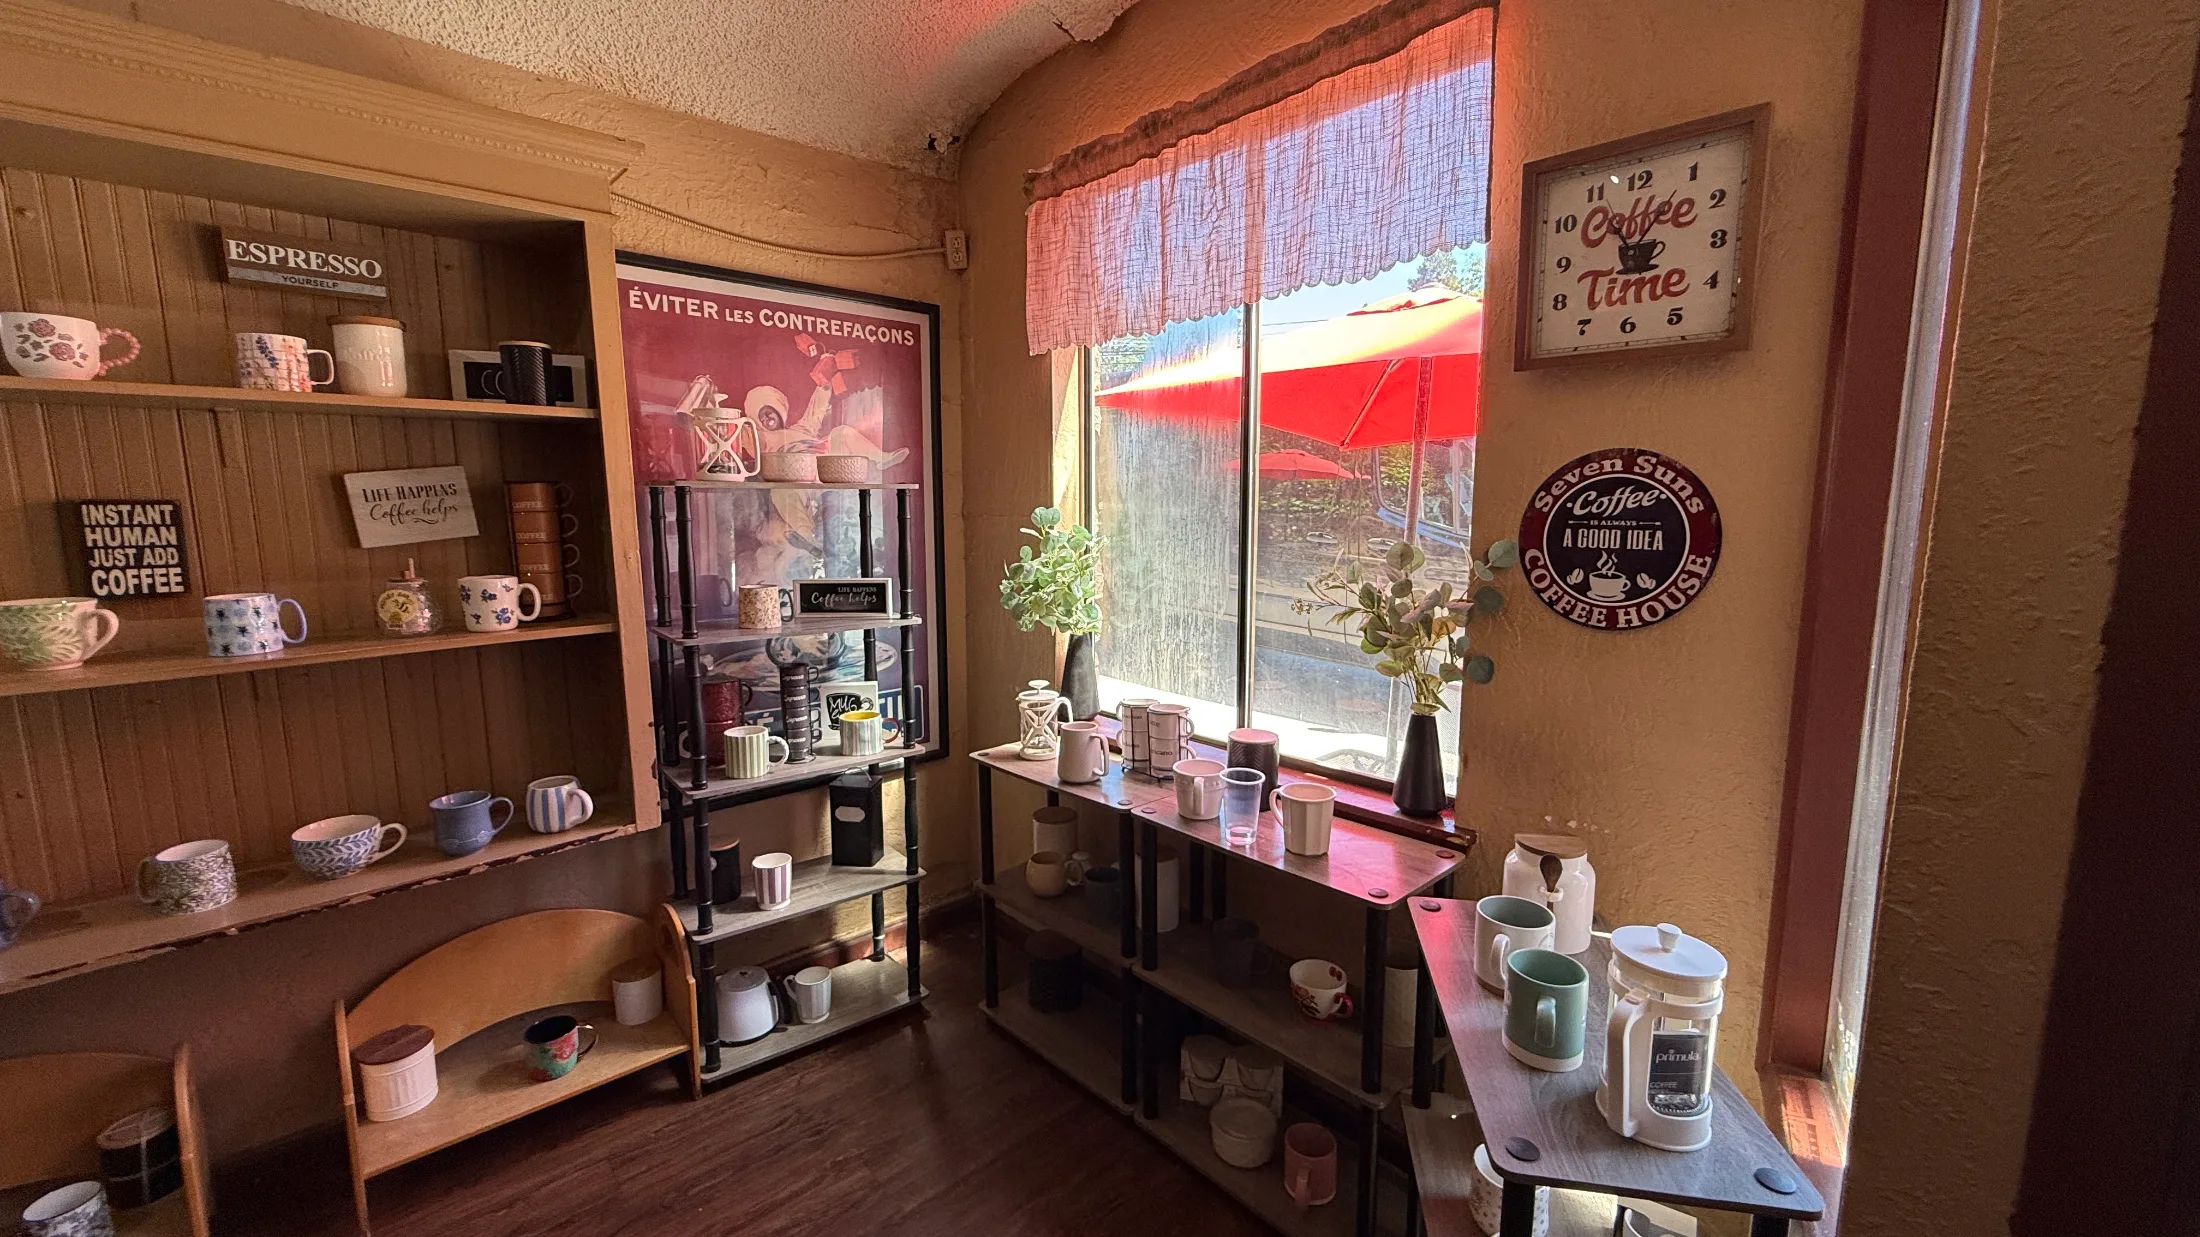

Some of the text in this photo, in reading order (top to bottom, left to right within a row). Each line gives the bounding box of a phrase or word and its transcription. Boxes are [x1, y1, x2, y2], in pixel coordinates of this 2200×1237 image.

[1627, 170, 1653, 192] 12
[1688, 162, 1698, 181] 1
[1586, 182, 1605, 203] 11
[1708, 188, 1727, 209] 2
[1555, 214, 1578, 234] 10
[1580, 194, 1698, 248] Coffee
[1709, 229, 1728, 249] 3
[226, 239, 383, 279] ESPRESSO
[1555, 256, 1572, 273] 9
[281, 275, 339, 290] YOURSELF
[1577, 267, 1690, 311] Time
[1702, 270, 1720, 290] 4
[1552, 293, 1568, 311] 8
[628, 286, 915, 347] ÉVITER LES CONTREFAÇONS
[1619, 316, 1637, 334] 6
[1666, 307, 1684, 326] 5
[1577, 318, 1592, 336] 7
[362, 482, 458, 503] LIFE HAPPENS
[1534, 455, 1705, 514] Seven Suns
[512, 501, 544, 509] COFFEE
[1573, 485, 1660, 517] Coffee
[81, 504, 173, 526] INSTANT
[369, 497, 458, 526] Coffee helps
[84, 526, 178, 547] HUMAN
[515, 532, 547, 540] COFFEE
[1563, 528, 1663, 551] A GOOD IDEA
[88, 547, 180, 568] JUST ADD
[520, 563, 551, 571] COFFEE
[91, 567, 185, 597] COFFEE
[1524, 548, 1712, 628] COFFEE HOUSE
[811, 592, 877, 607] Coffee helps
[829, 695, 858, 712] MUG
[1655, 1049, 1700, 1064] primula
[1649, 1081, 1678, 1089] COFFEE
